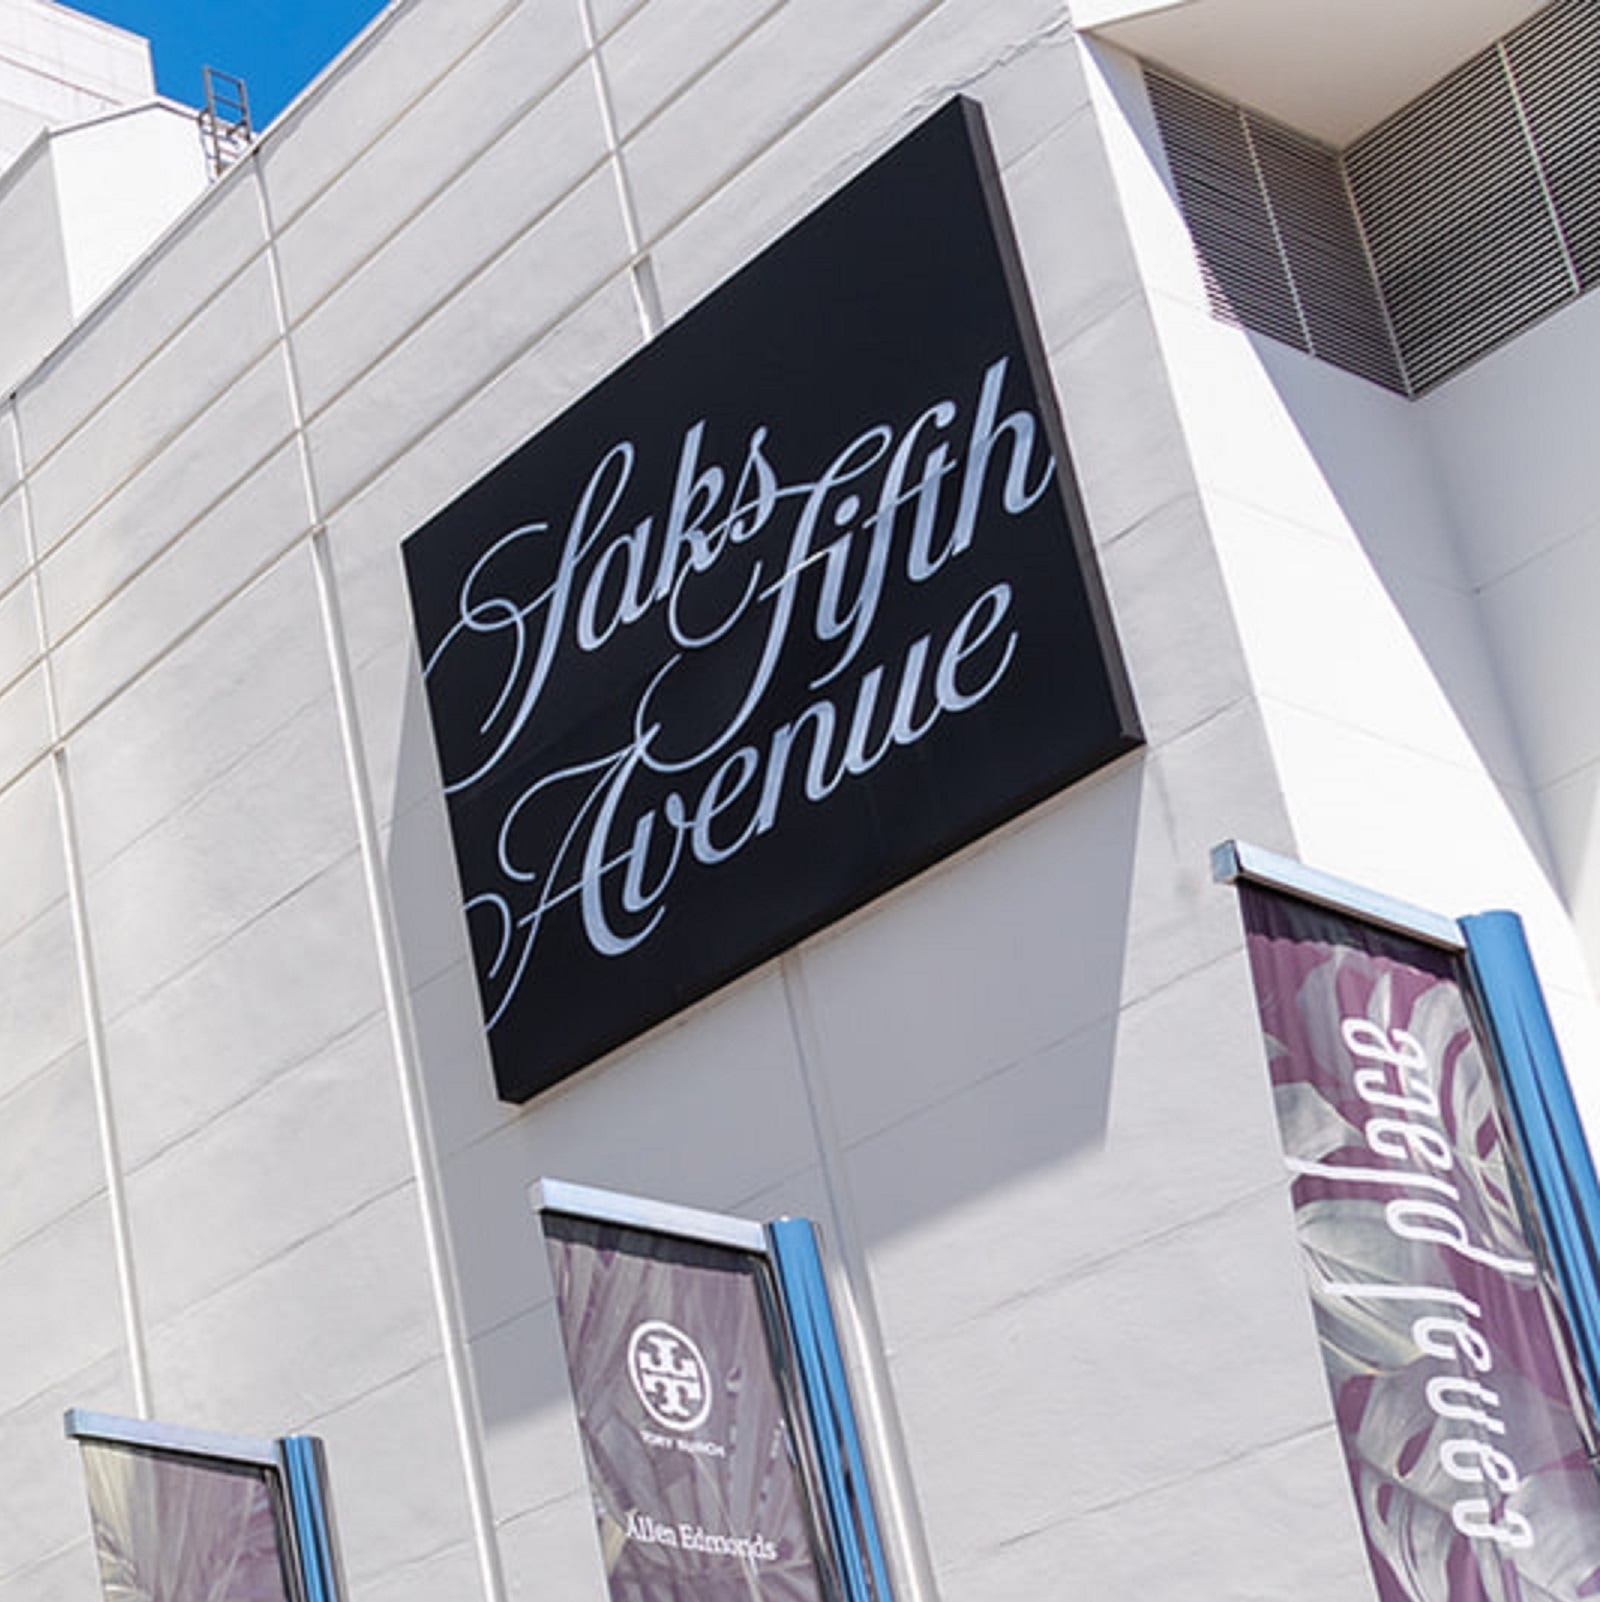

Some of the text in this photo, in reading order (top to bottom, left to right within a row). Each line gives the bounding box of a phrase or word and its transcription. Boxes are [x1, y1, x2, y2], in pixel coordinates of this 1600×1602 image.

[422, 419, 778, 794] Saks
[462, 583, 1019, 1031] Avenue
[1283, 1016, 1537, 1550] canal place
[626, 1511, 777, 1562] Allen Edmonds
